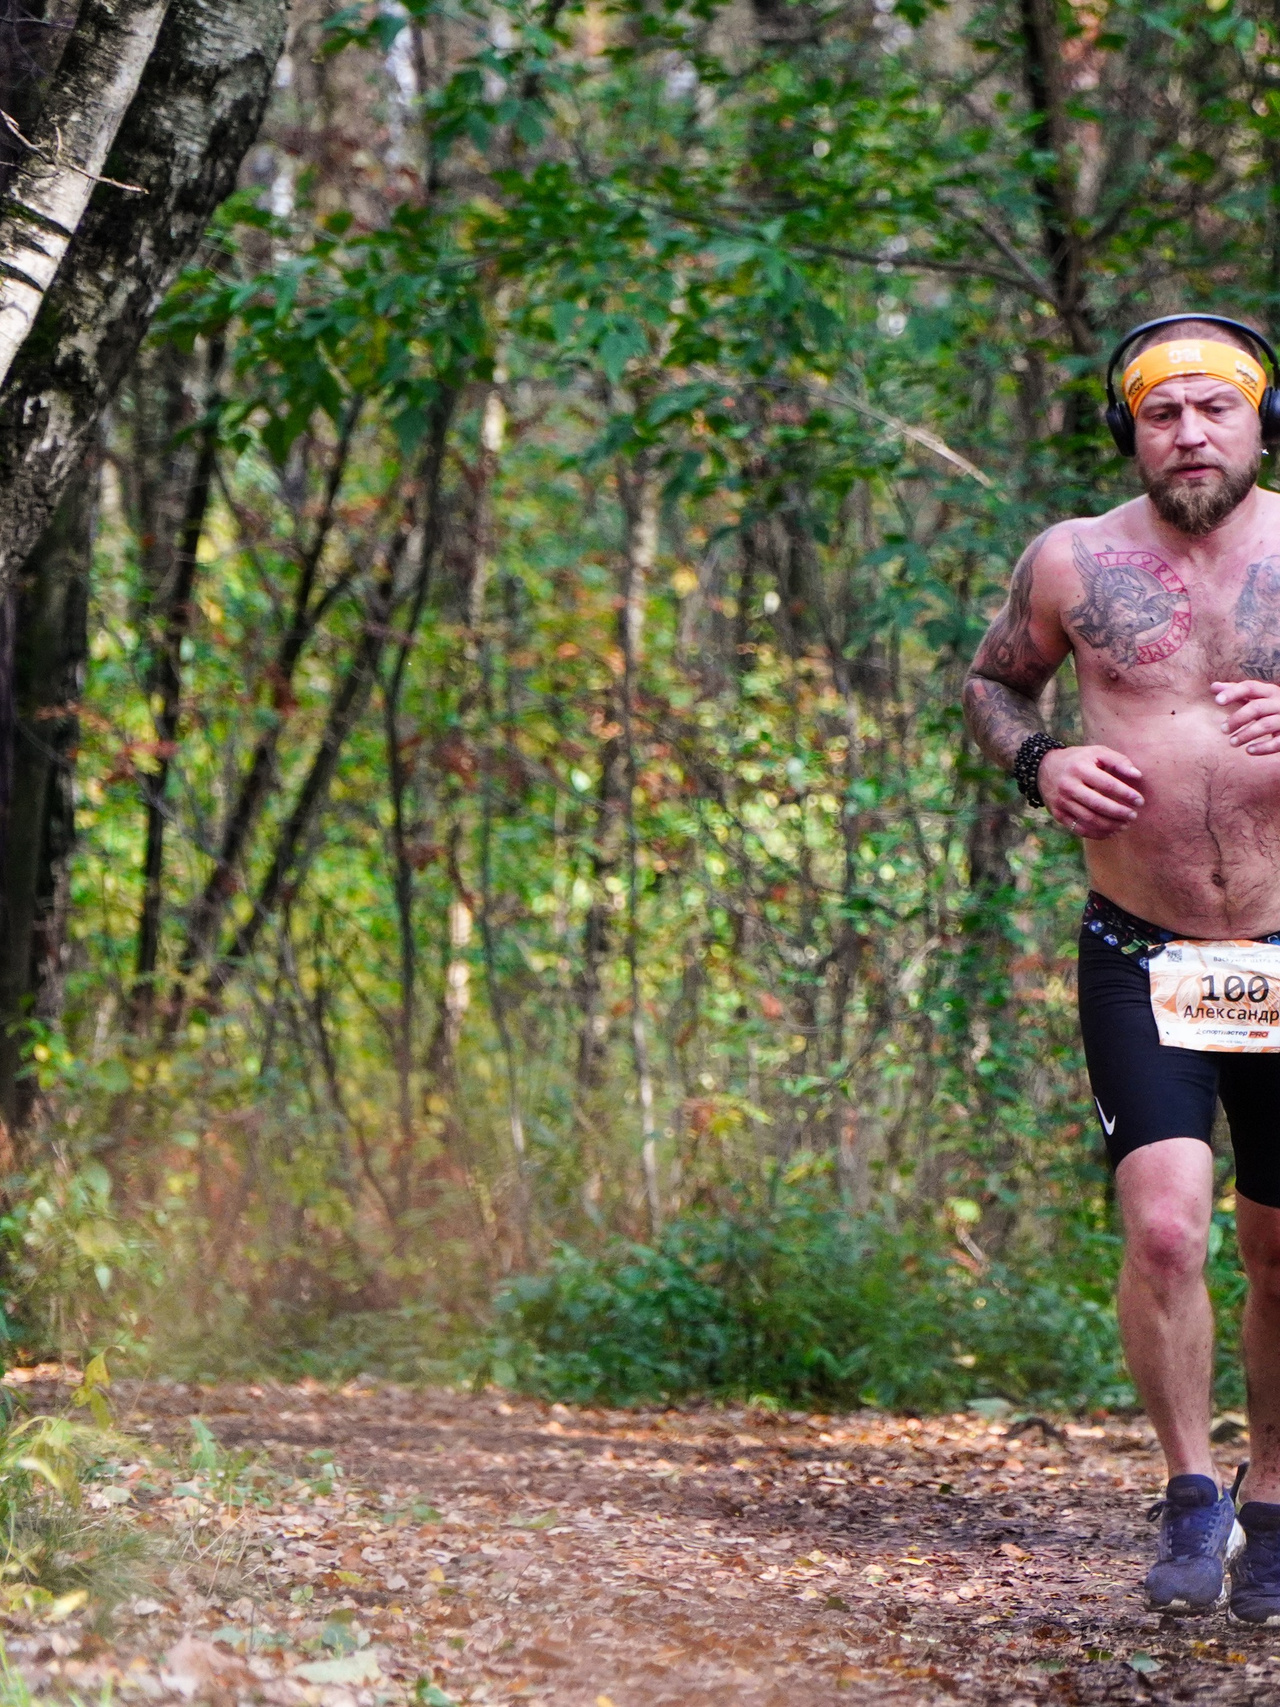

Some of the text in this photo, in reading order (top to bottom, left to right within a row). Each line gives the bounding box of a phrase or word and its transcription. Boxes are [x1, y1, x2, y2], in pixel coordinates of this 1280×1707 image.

[1201, 975, 1270, 1003] 100
[1183, 1005, 1280, 1024] Александр
[1249, 1030, 1269, 1038] PRO
